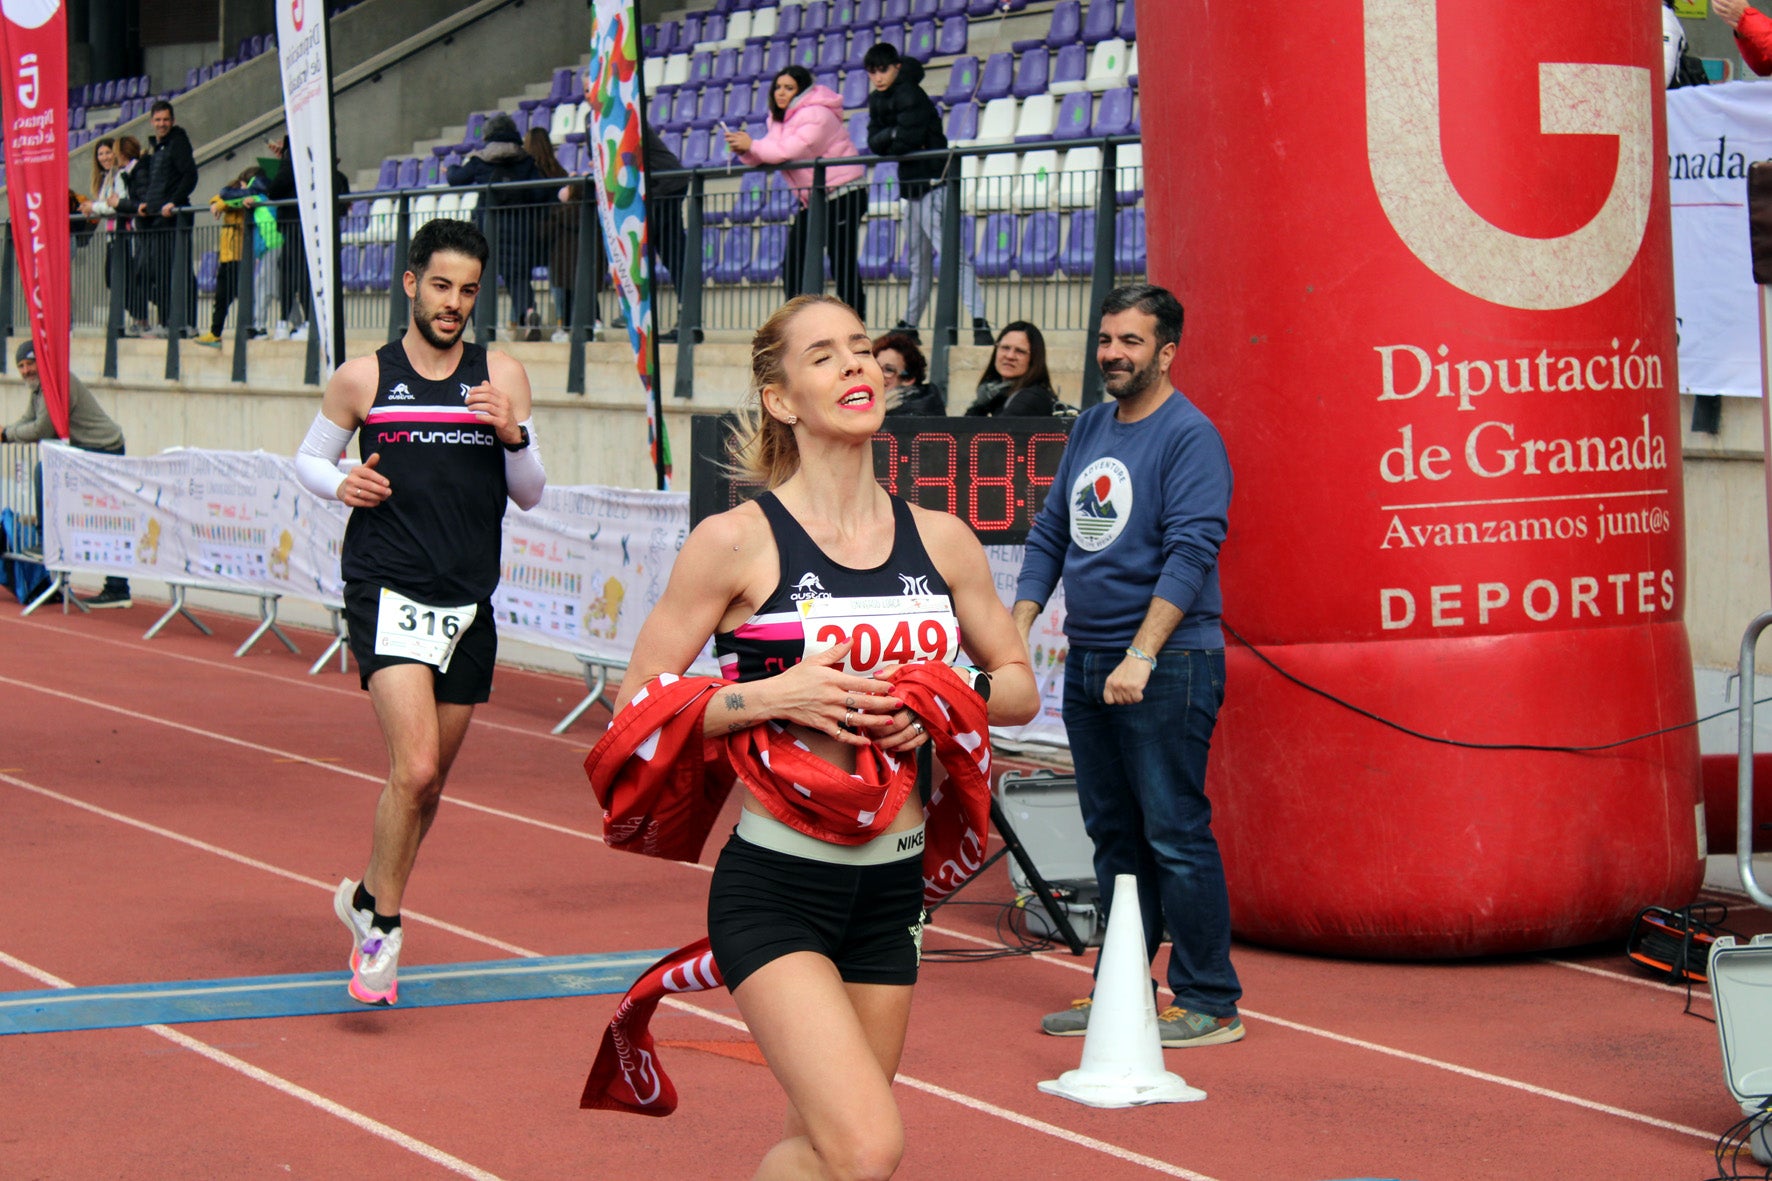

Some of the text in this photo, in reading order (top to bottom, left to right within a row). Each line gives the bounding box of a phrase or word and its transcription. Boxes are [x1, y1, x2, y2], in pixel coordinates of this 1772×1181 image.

[1373, 337, 1664, 411] Diputación
[377, 429, 494, 447] runrundata
[1380, 414, 1668, 484] de Granada
[1083, 460, 1126, 484] ADVENTURE
[1381, 505, 1671, 550] Avanzamos junt@s
[398, 604, 461, 640] 316
[1381, 571, 1676, 631] DEPORTES
[816, 619, 948, 672] 2049
[896, 830, 925, 852] NIKE
